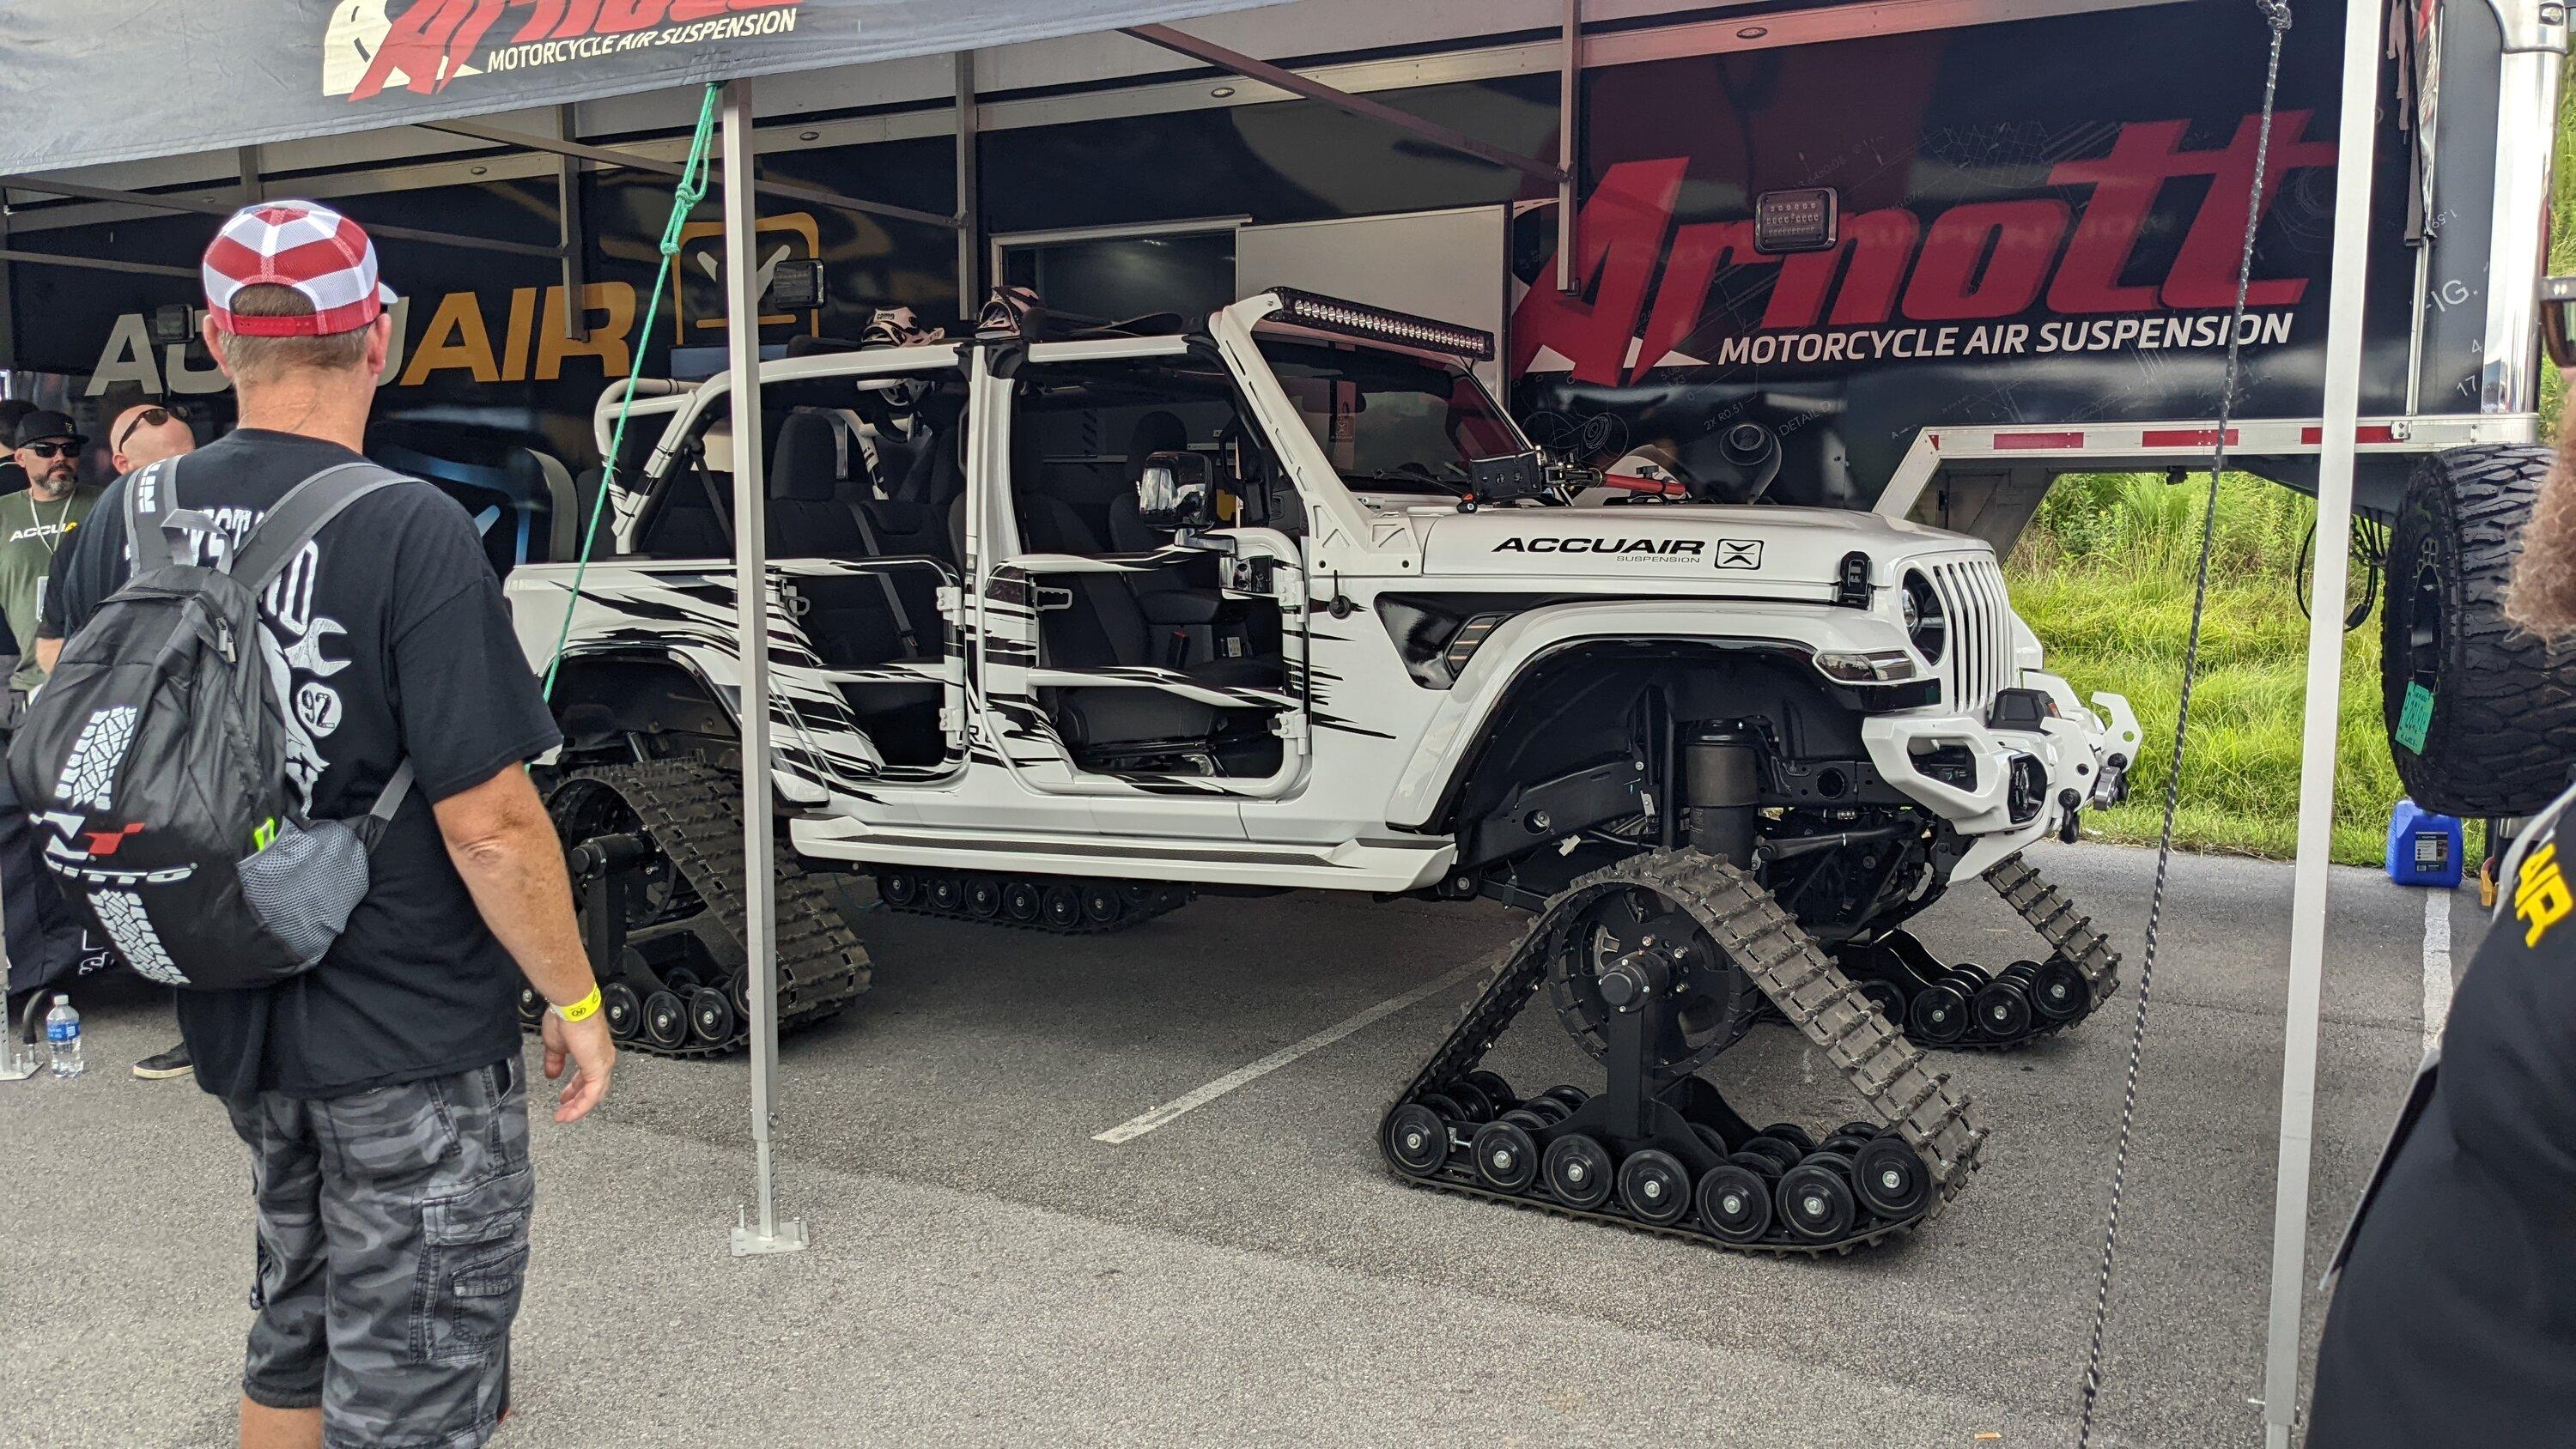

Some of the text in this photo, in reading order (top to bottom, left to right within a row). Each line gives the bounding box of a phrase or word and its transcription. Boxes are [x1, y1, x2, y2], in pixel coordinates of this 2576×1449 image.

[487, 9, 797, 74] MOTORCYCLE AIR SUSPENSION
[1511, 108, 2385, 388] Arnott
[2425, 280, 2478, 312] IG.
[84, 280, 638, 397] ACAIR
[1717, 312, 2293, 366] MOTORCYCLE AIR SUSPENSION
[1778, 409, 1820, 437] DETAIL
[1491, 537, 1705, 555] ACCUAIR
[301, 688, 336, 729] 92
